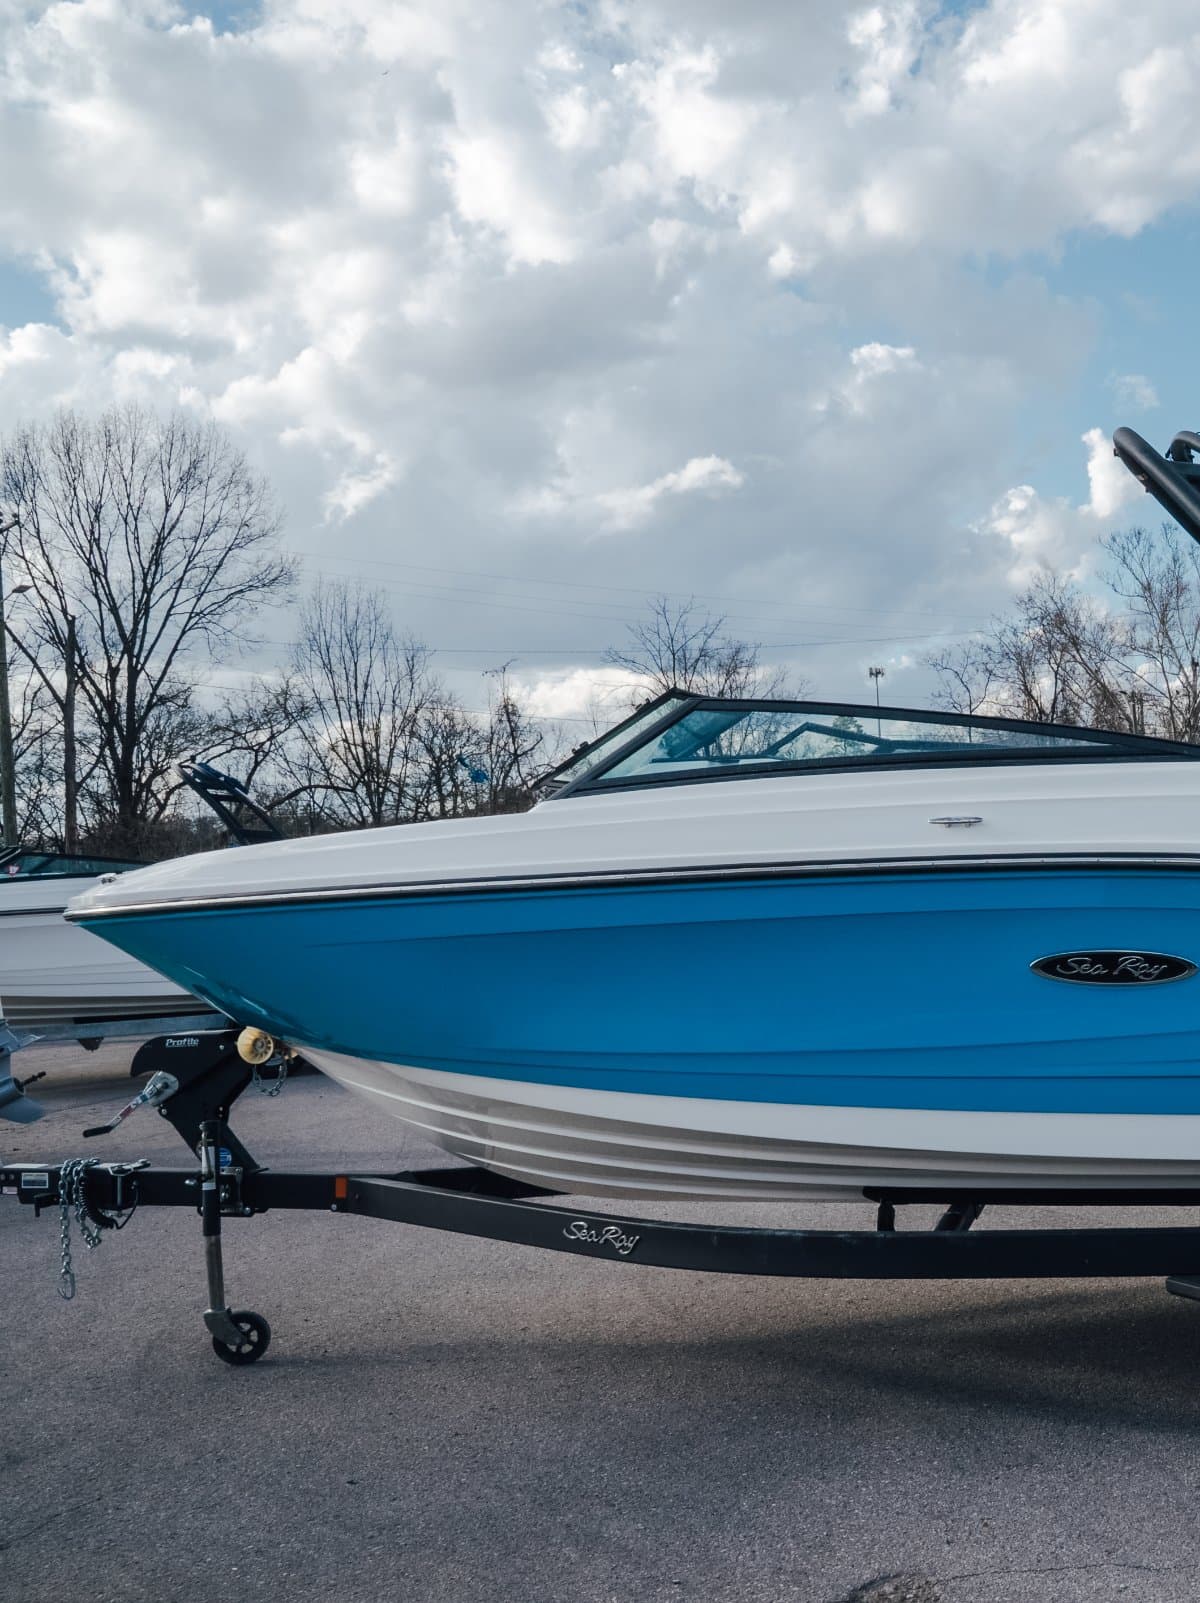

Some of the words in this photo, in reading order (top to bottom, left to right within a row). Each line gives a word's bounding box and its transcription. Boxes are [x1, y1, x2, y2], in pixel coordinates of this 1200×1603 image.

[1056, 957, 1109, 975] Sea
[1113, 955, 1168, 980] Ray
[562, 1221, 600, 1242] Sea
[599, 1226, 640, 1254] Ray
